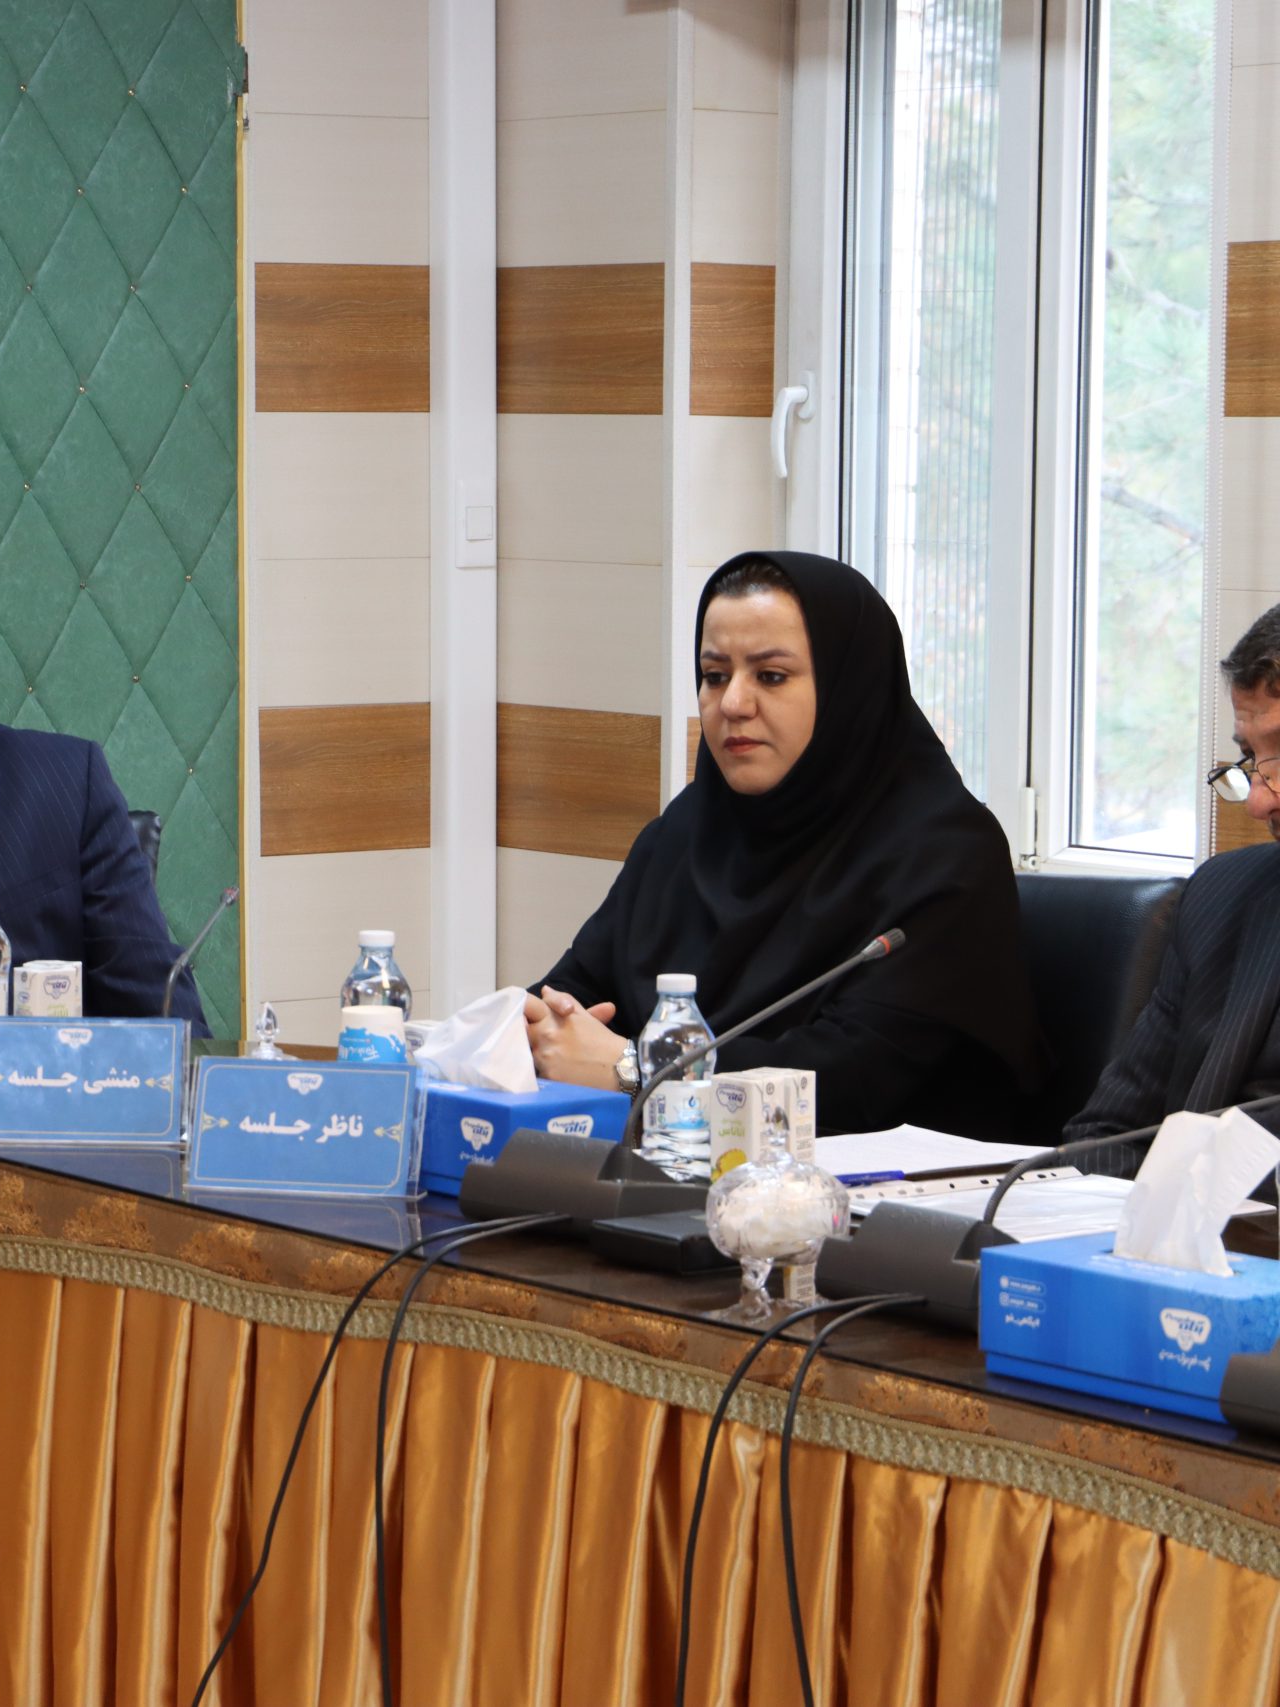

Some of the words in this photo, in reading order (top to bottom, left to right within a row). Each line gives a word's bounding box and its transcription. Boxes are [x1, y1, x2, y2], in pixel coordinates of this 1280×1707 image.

[7, 1065, 78, 1093] جلسه
[83, 1067, 140, 1094] منشی
[239, 1112, 311, 1141] جلسه
[315, 1113, 363, 1143] ناظر
